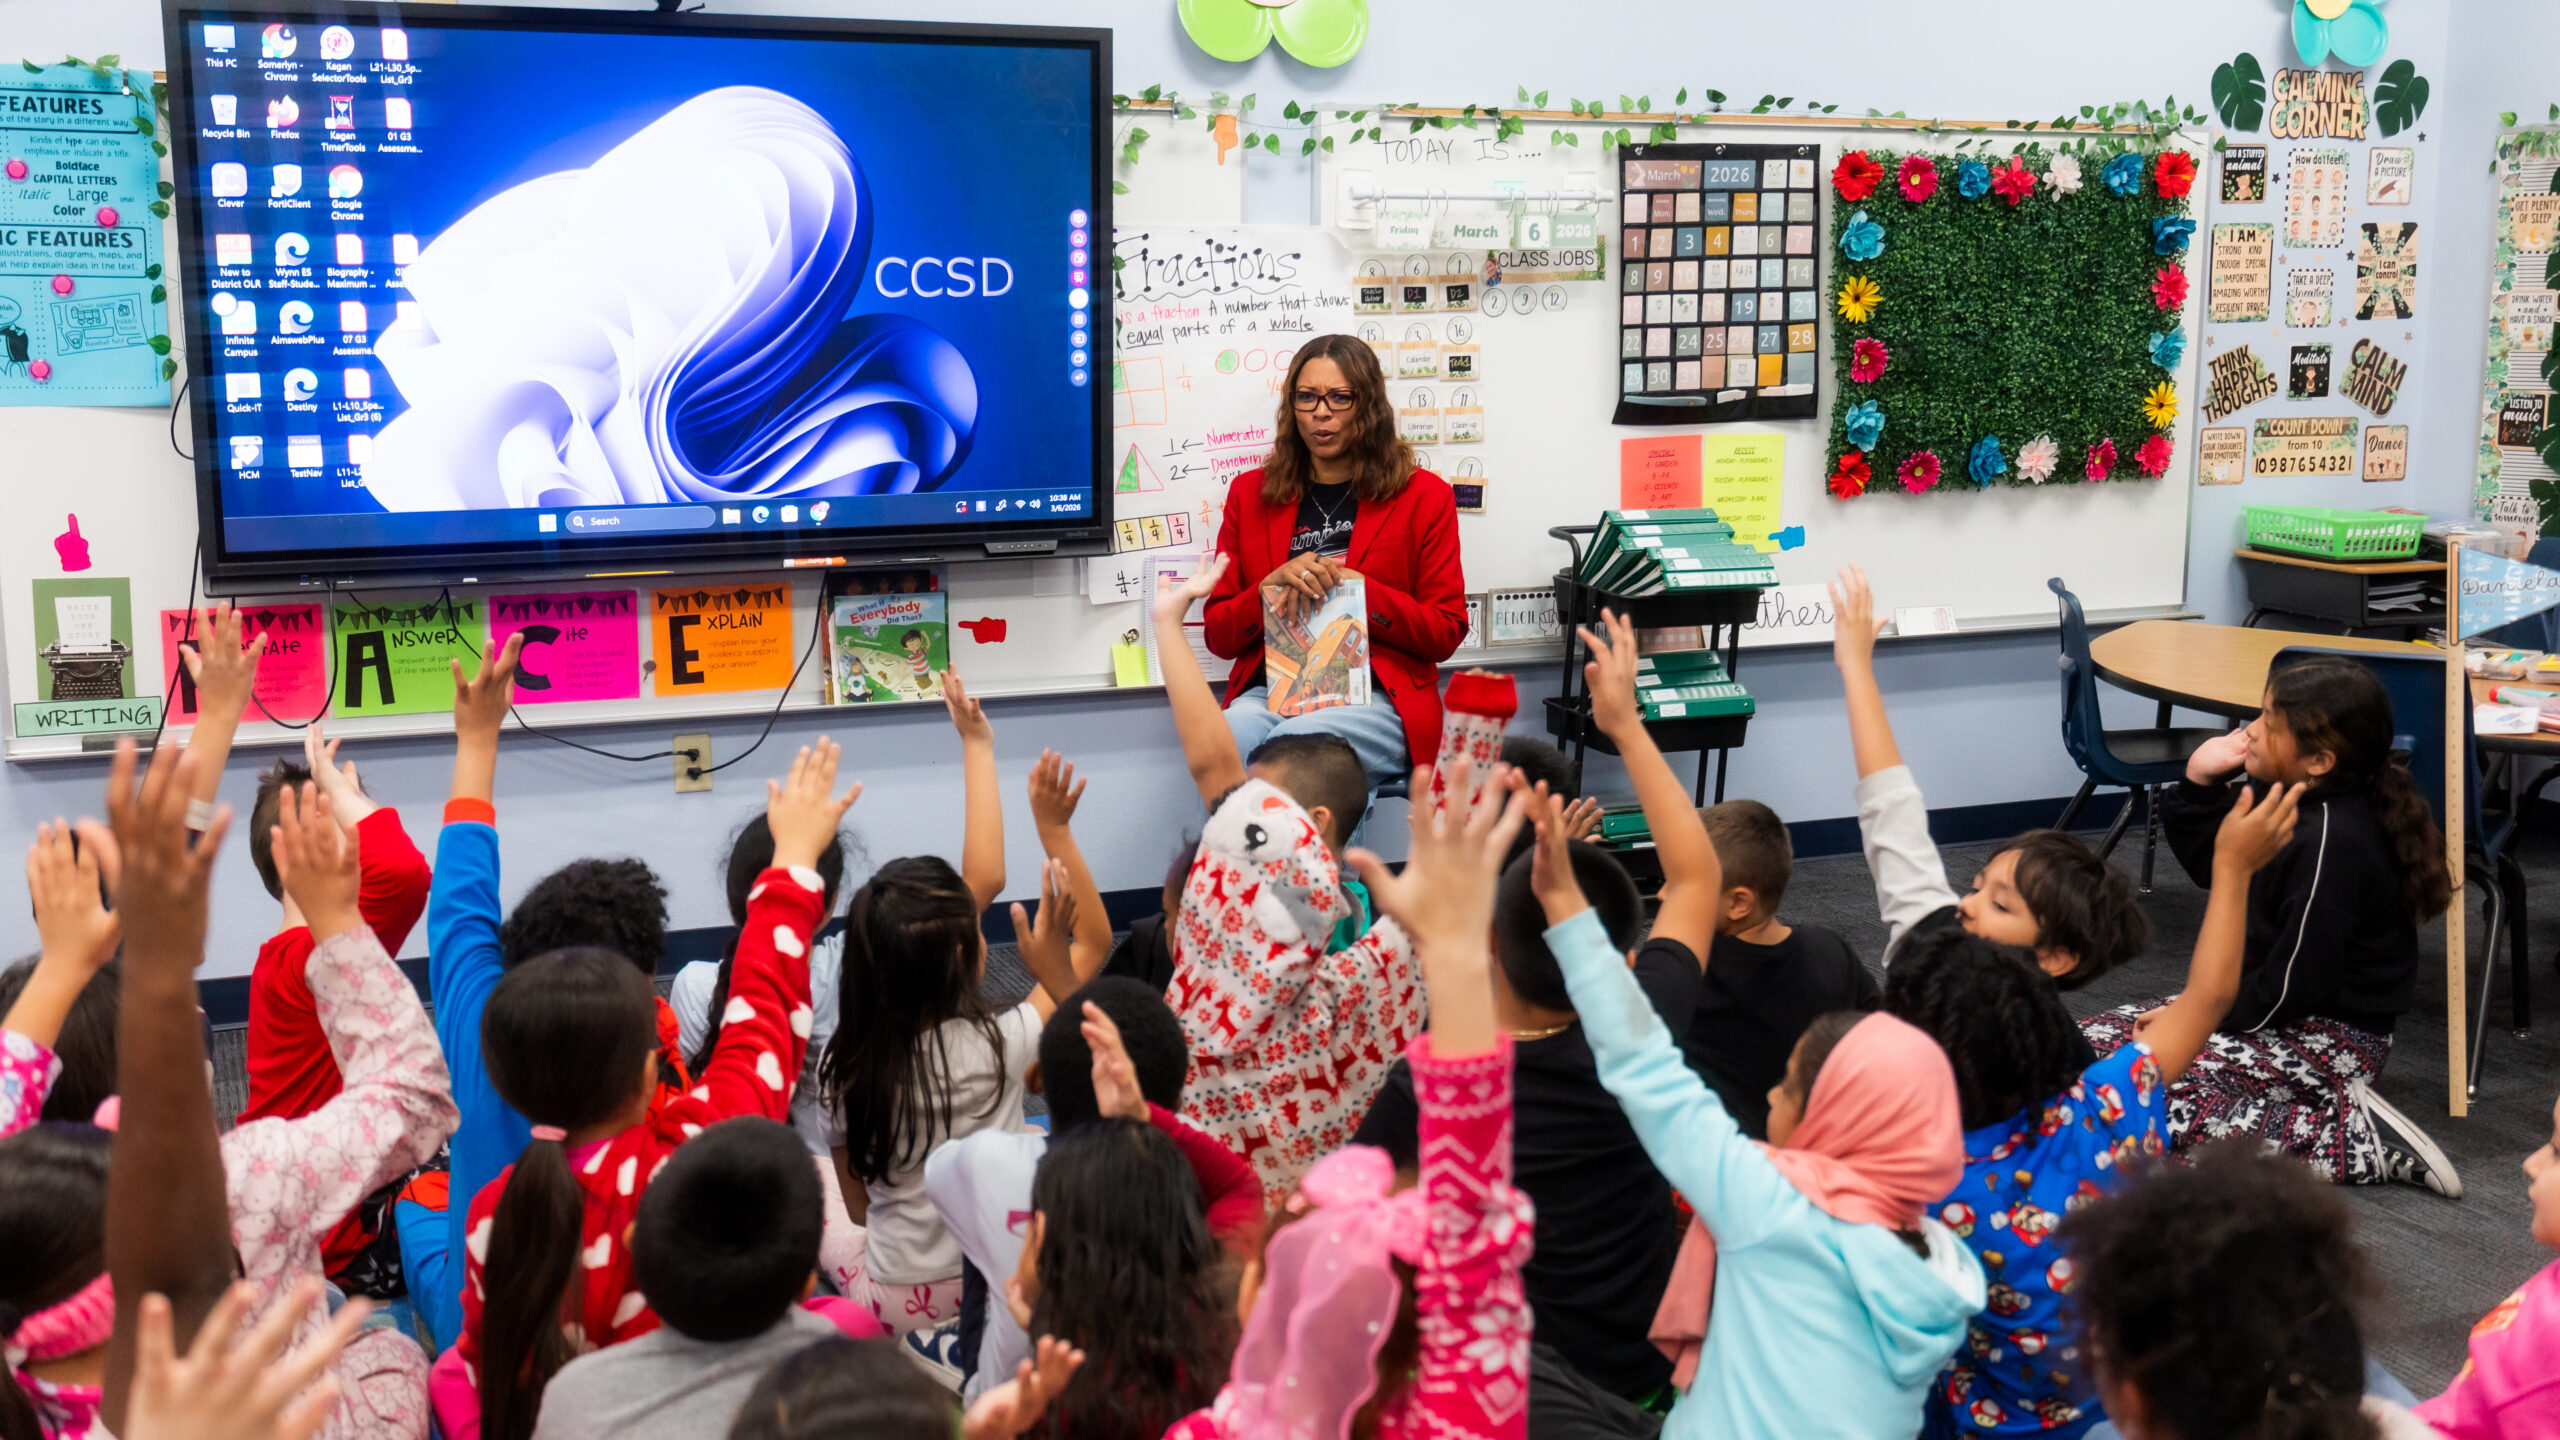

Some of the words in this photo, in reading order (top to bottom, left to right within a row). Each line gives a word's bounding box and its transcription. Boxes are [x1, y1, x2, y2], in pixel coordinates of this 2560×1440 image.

[206, 59, 222, 67] This
[224, 59, 237, 67] PC
[258, 60, 295, 70] Somerlyn
[326, 62, 351, 71] Kagan
[265, 73, 298, 81] Chrome
[312, 74, 366, 83] SelectorTools
[2273, 68, 2365, 104] CALMING
[2270, 101, 2367, 140] CORNER
[203, 130, 234, 139] Recycle
[237, 130, 250, 138] Bin
[271, 130, 299, 139] Firefox
[330, 132, 355, 141] Kagan
[66, 137, 82, 147] type
[321, 144, 366, 152] TimerTools
[1373, 138, 1454, 164] TODAY
[2226, 150, 2236, 158] HUG
[2238, 149, 2242, 158] A
[2243, 149, 2265, 158] STUFFED
[2296, 155, 2311, 165] How
[2313, 154, 2322, 165] do
[2376, 153, 2402, 165] Draw
[56, 161, 99, 171] Boldface
[2226, 160, 2263, 171] animal
[34, 175, 74, 184] CAPITAL
[78, 176, 117, 185] LETTERS
[1647, 170, 1680, 181] March
[1711, 167, 1749, 183] 2026
[19, 189, 51, 200] Italic
[69, 188, 108, 204] Large
[218, 199, 244, 208] Clever
[268, 200, 310, 208] FortiClient
[332, 200, 362, 209] Google
[2515, 201, 2528, 211] GET
[2532, 200, 2559, 212] PLENTY
[54, 205, 85, 216] Color
[1708, 208, 1726, 216] Wed.
[331, 212, 363, 220] Chrome
[2519, 214, 2529, 223] OF
[2531, 213, 2552, 224] SLEEP
[1390, 226, 1419, 236] Friday
[1454, 224, 1498, 238] March
[1528, 224, 1540, 241] 6
[1556, 224, 1591, 238] 2026
[28, 231, 132, 248] FEATURES
[2218, 246, 2242, 255] STRONG
[2249, 245, 2262, 255] KIND
[1499, 251, 1549, 268] CLASS
[1553, 250, 1594, 266] JOBS
[2216, 259, 2240, 269] ENOUGH
[2245, 259, 2267, 268] SPECIAL
[220, 268, 238, 276] New
[276, 268, 300, 277] Wynn
[302, 268, 312, 276] ES
[327, 268, 368, 278] Biography
[875, 256, 1014, 298] CCSD
[1791, 266, 1809, 280] 14
[2376, 270, 2398, 279] control
[2224, 274, 2257, 283] IMPORTANT
[2293, 275, 2307, 285] TAKE
[2309, 275, 2313, 284] A
[2316, 275, 2331, 285] DEEP
[212, 280, 241, 288] District
[244, 280, 261, 288] OLR
[327, 280, 368, 288] Maximum
[1451, 288, 1464, 299] D2
[2213, 287, 2241, 297] AMAZING
[2244, 287, 2269, 297] WORTHY
[2512, 295, 2529, 303] DRINK
[2532, 295, 2553, 303] WATER
[1138, 312, 1147, 322] a
[1209, 300, 1217, 316] A
[1225, 299, 1272, 314] number
[1279, 294, 1311, 310] that
[1314, 291, 1350, 306] shows
[1736, 300, 1753, 315] 19
[1794, 299, 1812, 313] 21
[2216, 303, 2244, 313] RESILIENT
[2246, 303, 2264, 312] BRAVE
[2524, 305, 2541, 314] and
[1127, 326, 1164, 346] equal
[1173, 321, 1209, 342] parts
[1220, 319, 1235, 334] of
[1248, 321, 1256, 331] a
[226, 336, 254, 344] Infinite
[271, 336, 324, 345] AimswebPlus
[1625, 336, 1639, 350] 22
[1679, 334, 1698, 349] 24
[1707, 333, 1723, 349] 25
[1761, 332, 1777, 347] 27
[1792, 330, 1812, 346] 28
[224, 348, 257, 358] Campus
[2209, 344, 2251, 380] THINK
[2292, 352, 2328, 365] Meditate
[2351, 338, 2408, 390] CALM
[1628, 370, 1641, 386] 29
[1650, 369, 1668, 384] 30
[2212, 363, 2258, 398] HAPPY
[2202, 372, 2278, 423] THOUGHTS
[2349, 373, 2394, 416] MIND
[227, 404, 262, 413] Quick-IT
[287, 403, 317, 412] Destiny
[2510, 399, 2533, 409] LISTEN
[2534, 399, 2543, 408] TO
[2503, 408, 2540, 422] music
[1452, 422, 1477, 430] Clean-up
[2270, 419, 2306, 435] COUNT
[2311, 419, 2343, 435] DOWN
[1207, 426, 1269, 448] Numerator
[2207, 432, 2222, 441] WRITE
[2224, 432, 2241, 441] DOWN
[2203, 442, 2216, 450] YOUR
[2218, 442, 2242, 450] THOUGHTS
[2288, 440, 2310, 450] from
[2313, 440, 2322, 449] 10
[2368, 435, 2403, 453] Dance
[2204, 452, 2213, 460] AND
[2215, 452, 2241, 460] EMOTIONS
[239, 471, 259, 479] HCM
[291, 469, 322, 477] TestNav
[1050, 494, 1068, 502] 10:38
[1050, 504, 1081, 512] 3/6/2026
[2500, 501, 2519, 514] Talk
[2523, 502, 2529, 514] to
[590, 516, 620, 526] Search
[2494, 514, 2535, 524] someone
[858, 602, 877, 612] What
[849, 601, 920, 624] Everybody
[1497, 611, 1536, 625] PENCIL
[36, 705, 152, 728] WRITING
